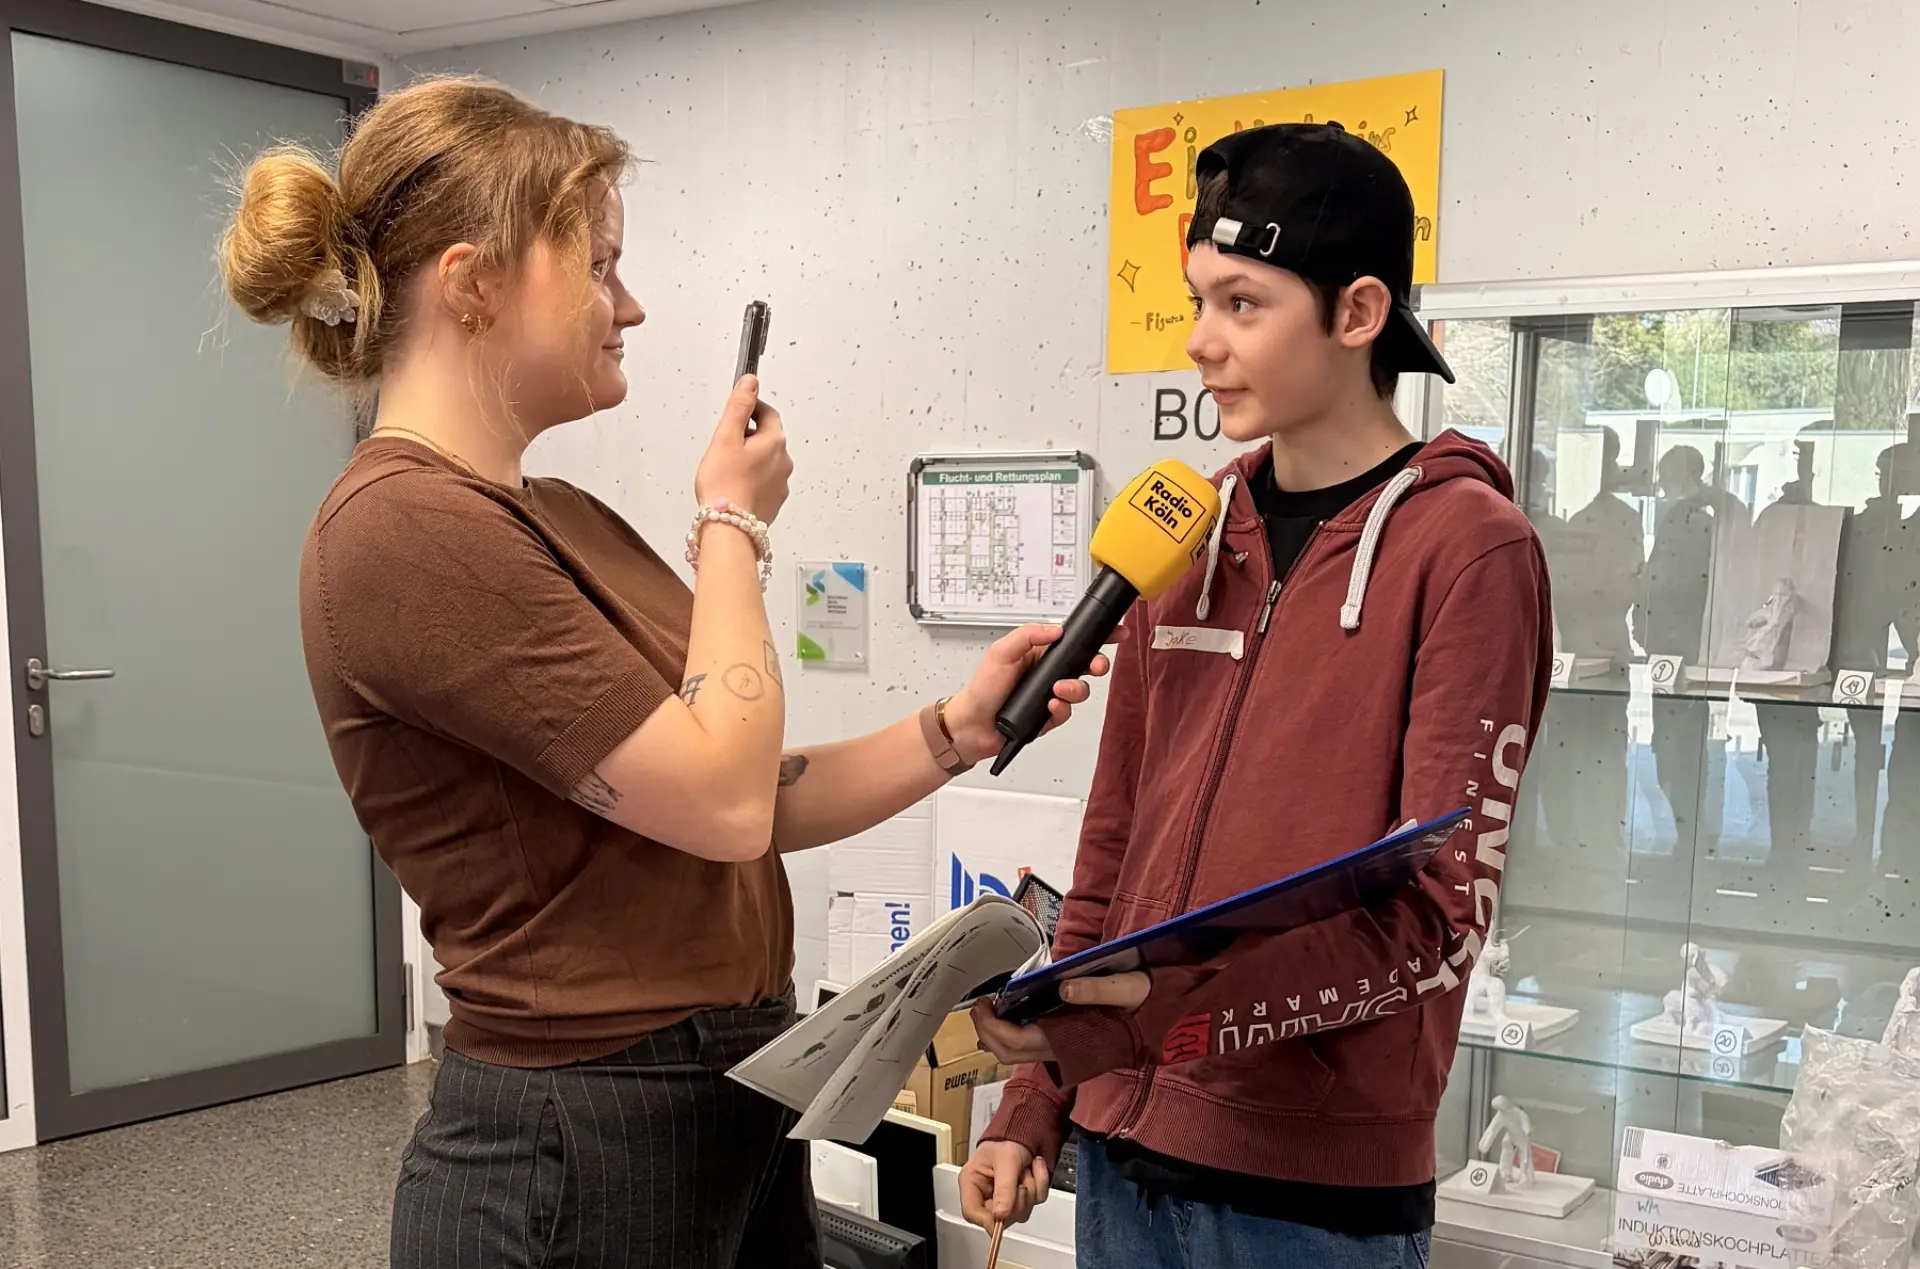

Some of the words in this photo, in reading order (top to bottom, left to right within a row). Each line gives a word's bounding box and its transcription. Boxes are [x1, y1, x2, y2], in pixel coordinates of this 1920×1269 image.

[1134, 126, 1197, 216] Ei
[939, 472, 973, 483] Flucht-
[974, 472, 993, 482] und
[995, 471, 1061, 483] Rettungsplan
[1143, 495, 1179, 530] Köln
[1150, 480, 1193, 519] Radio
[1454, 718, 1494, 896] FINEST
[1221, 925, 1461, 1025] TADEMARK
[1639, 1173, 1669, 1189] studio
[1676, 1182, 1785, 1210] IONSKOCHPLATTE
